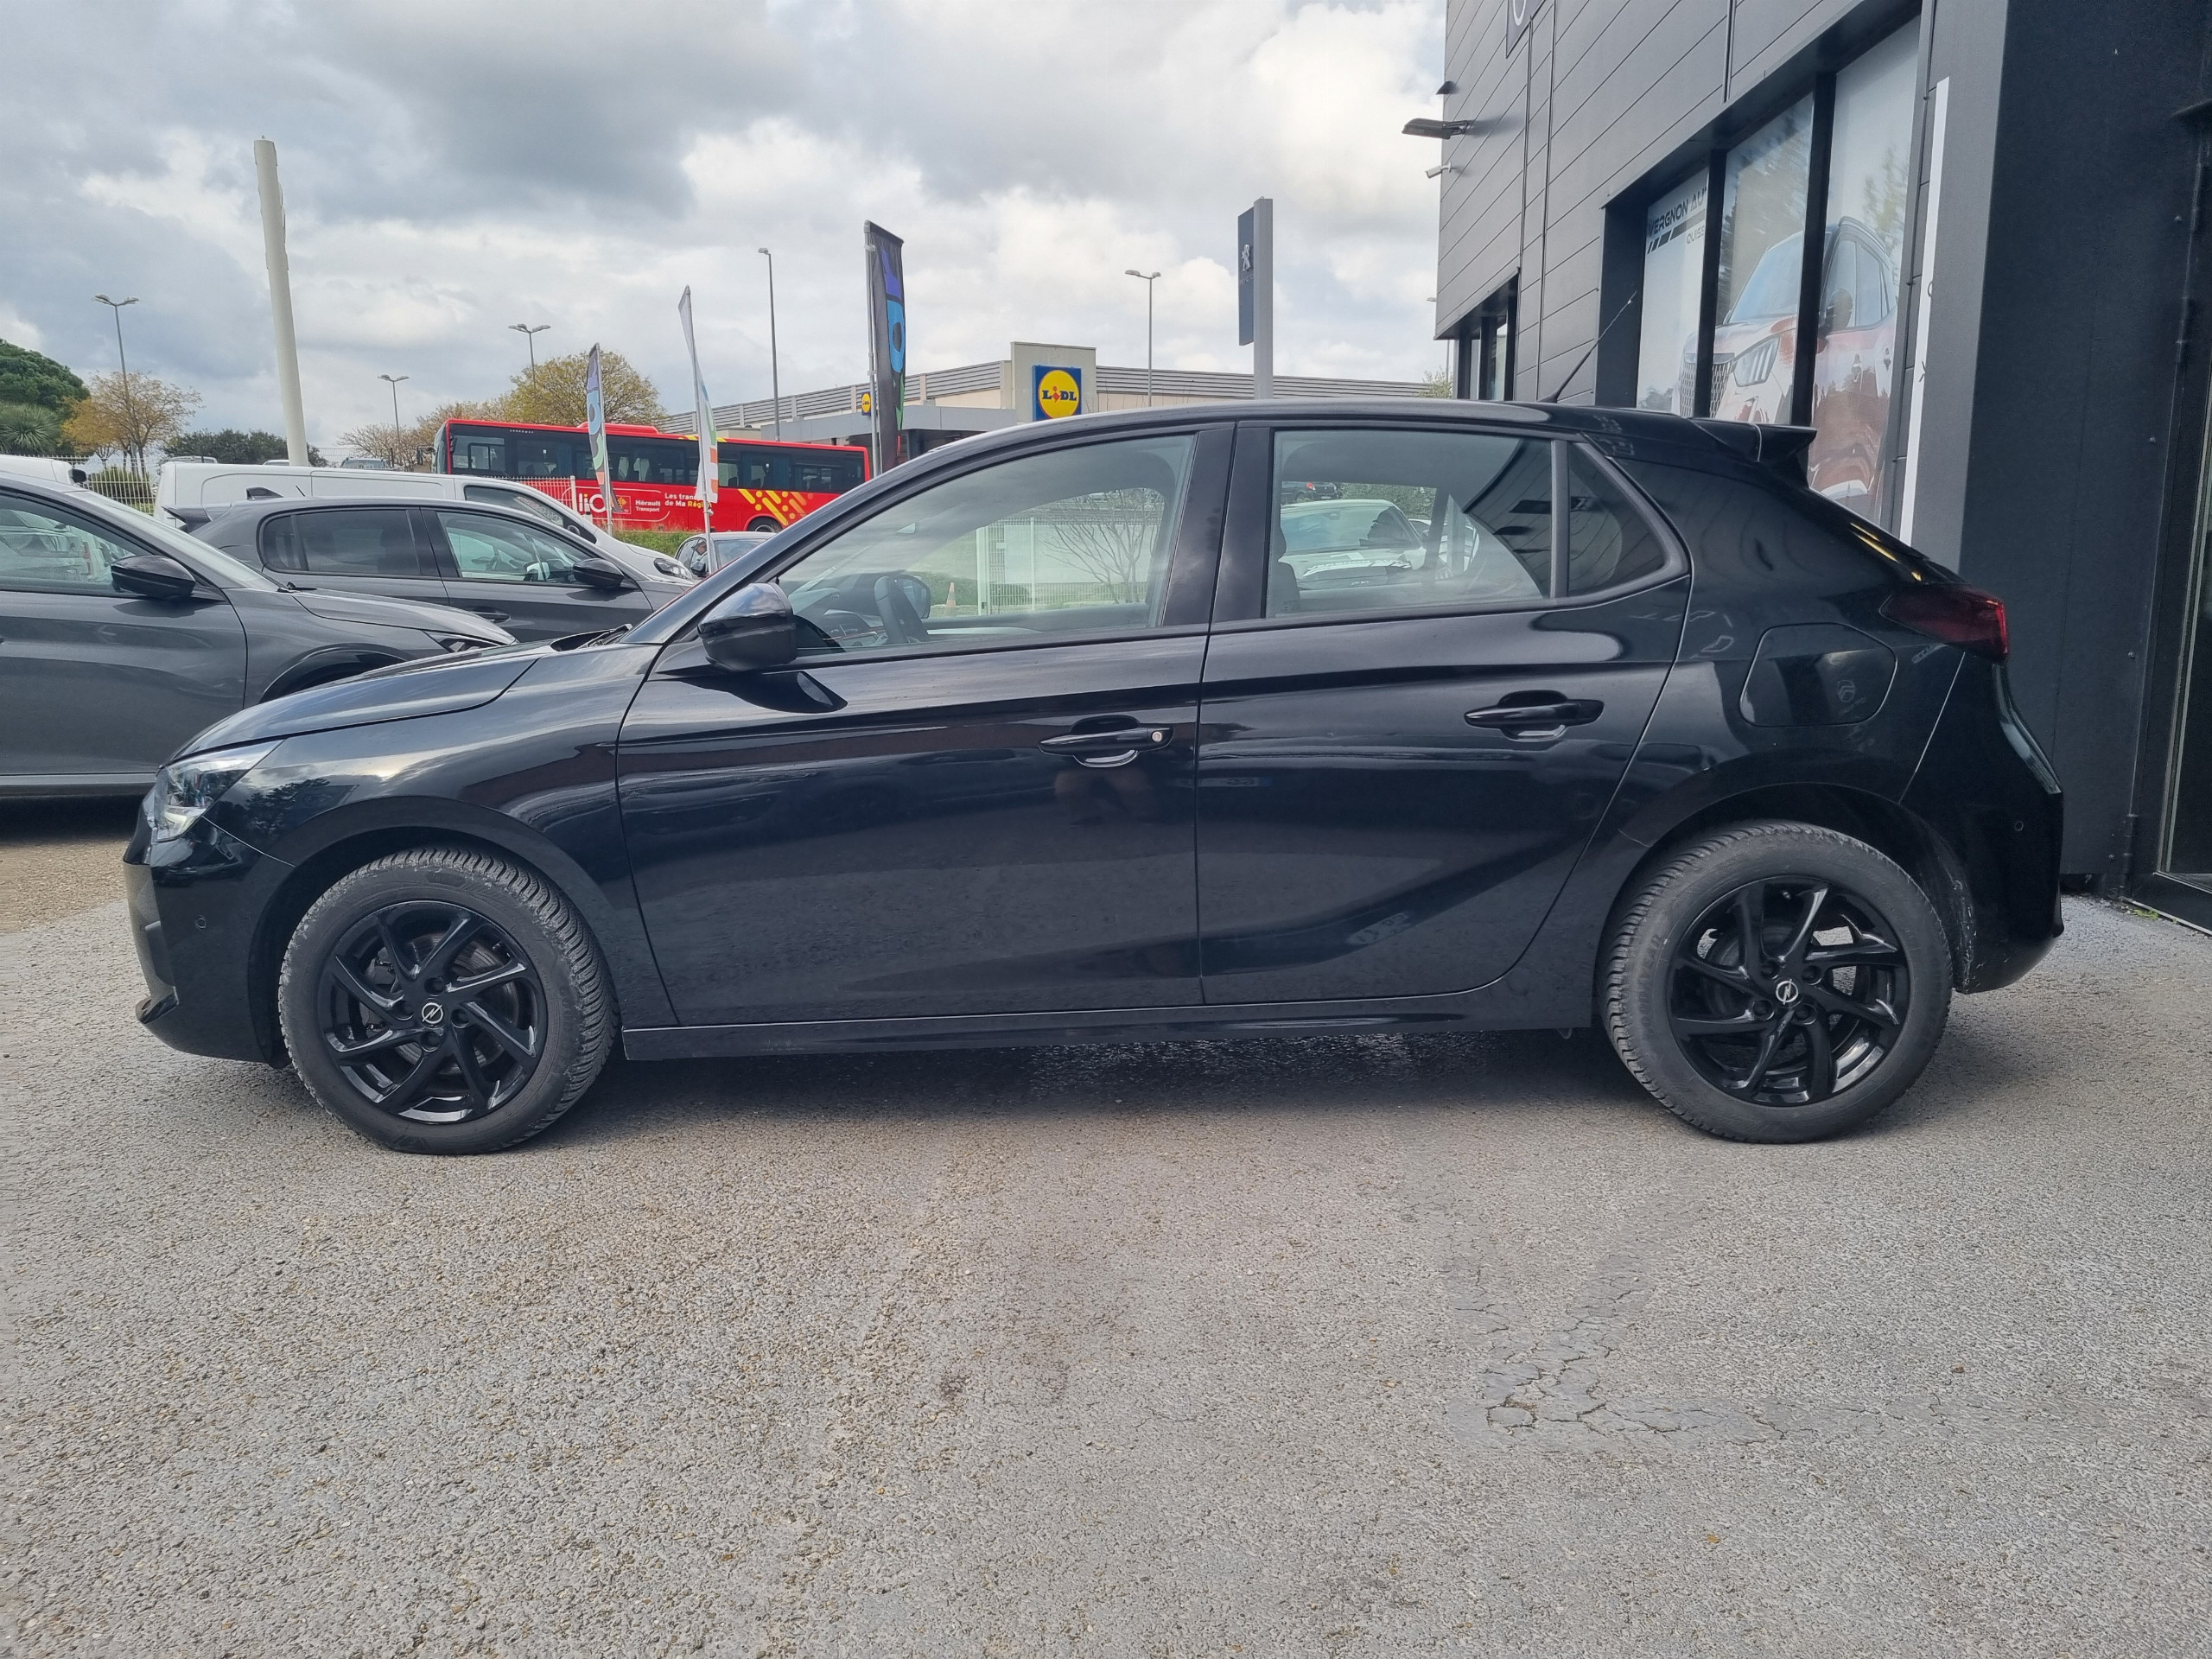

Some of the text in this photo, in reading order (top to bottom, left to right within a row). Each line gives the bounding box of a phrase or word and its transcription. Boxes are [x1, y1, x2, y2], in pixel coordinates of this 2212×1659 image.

[1649, 187, 1707, 237] VERGNON AU
[687, 500, 712, 509] Régin
